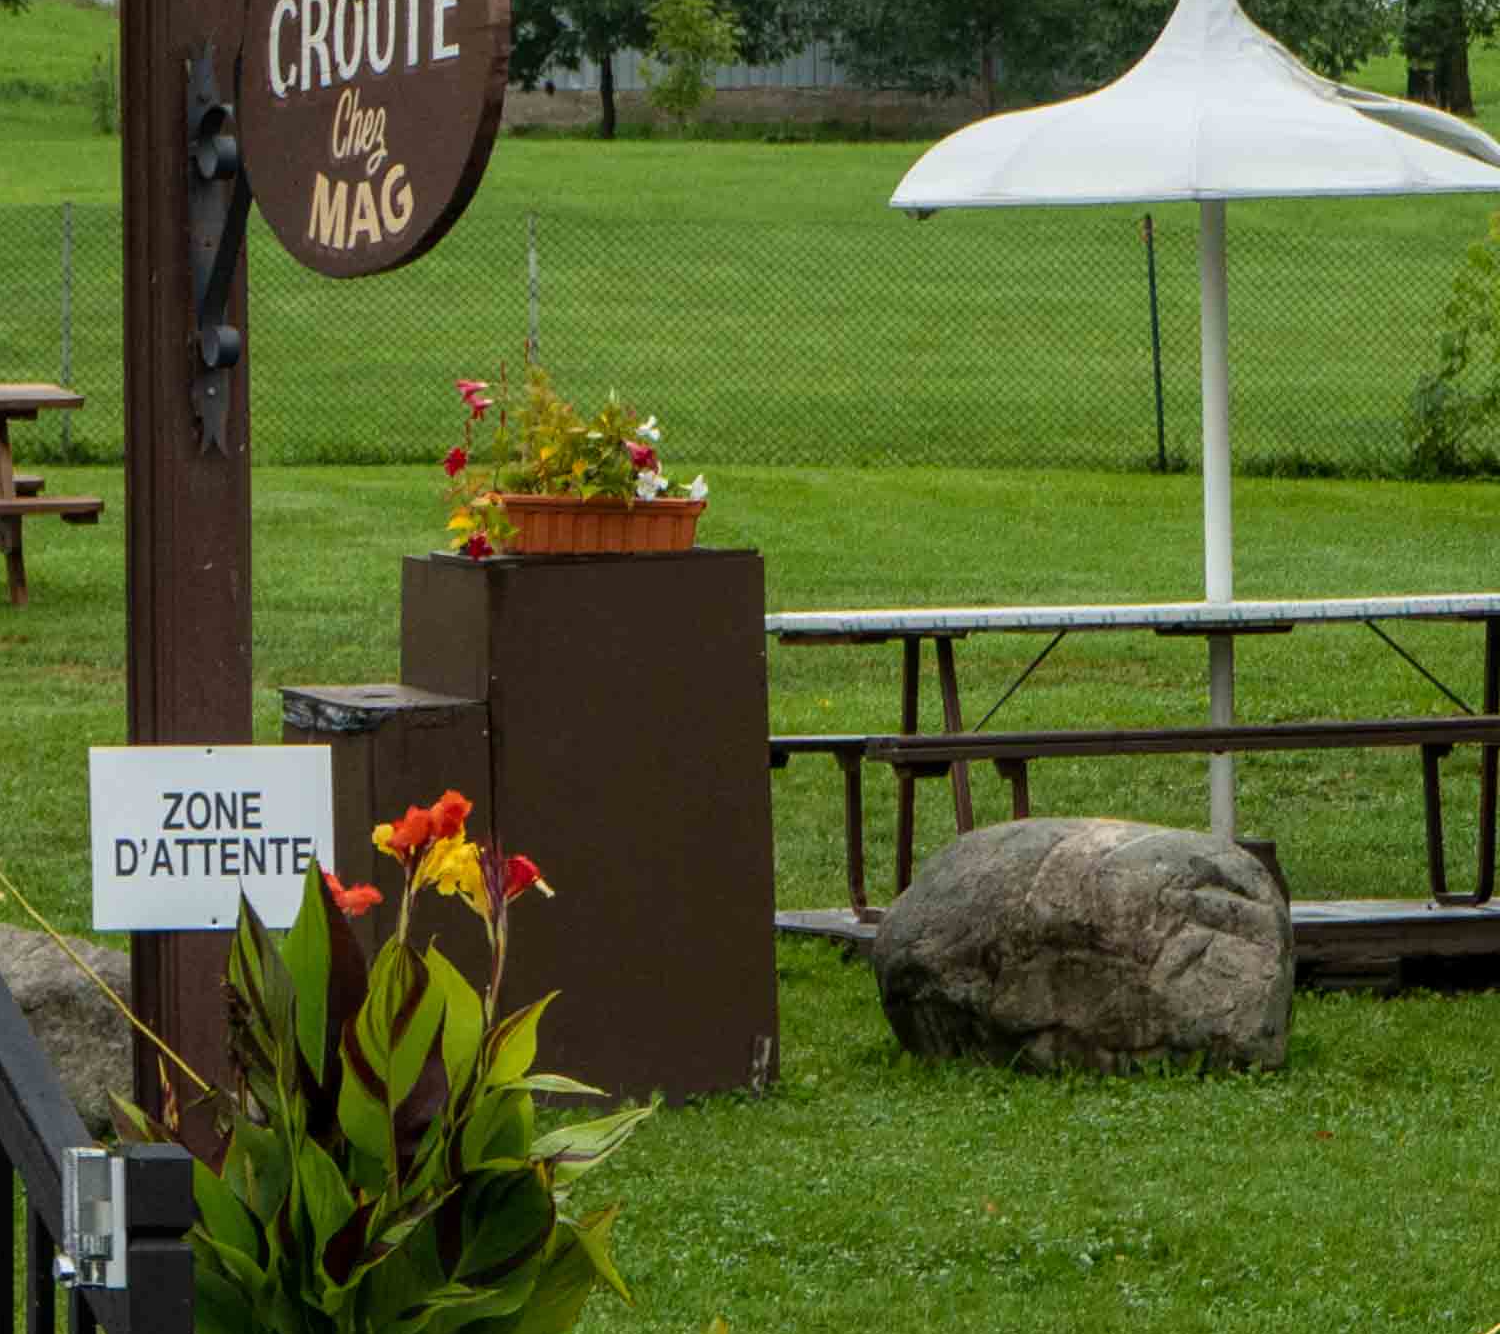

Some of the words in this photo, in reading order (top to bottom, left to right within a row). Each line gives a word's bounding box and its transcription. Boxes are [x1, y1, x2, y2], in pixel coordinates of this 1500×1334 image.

[332, 89, 388, 176] Chez
[308, 164, 413, 250] MAG
[162, 791, 263, 830] ZONE
[115, 836, 313, 877] D'ATTENTE
